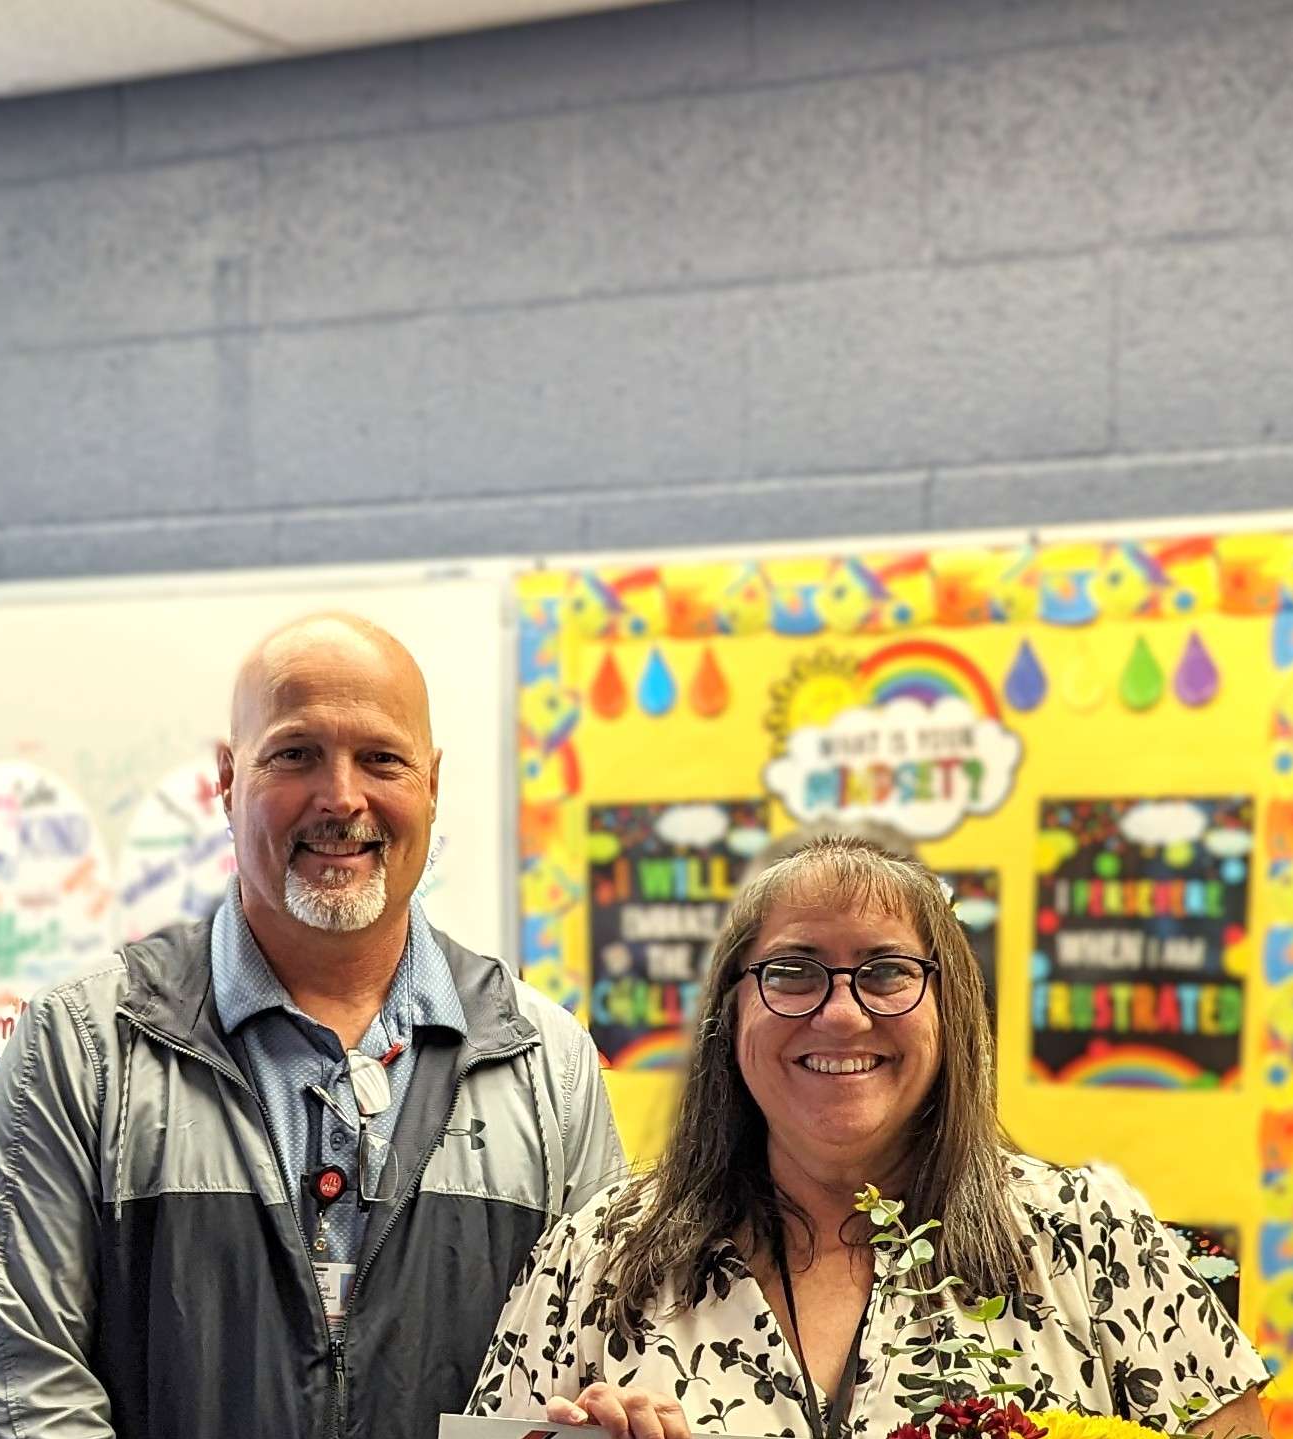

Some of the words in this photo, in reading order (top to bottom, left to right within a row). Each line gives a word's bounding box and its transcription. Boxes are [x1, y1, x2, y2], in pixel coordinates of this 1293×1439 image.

[804, 757, 985, 809] MINDSET?
[639, 856, 734, 900] WILL
[1032, 982, 1244, 1035] FRUSTRATED
